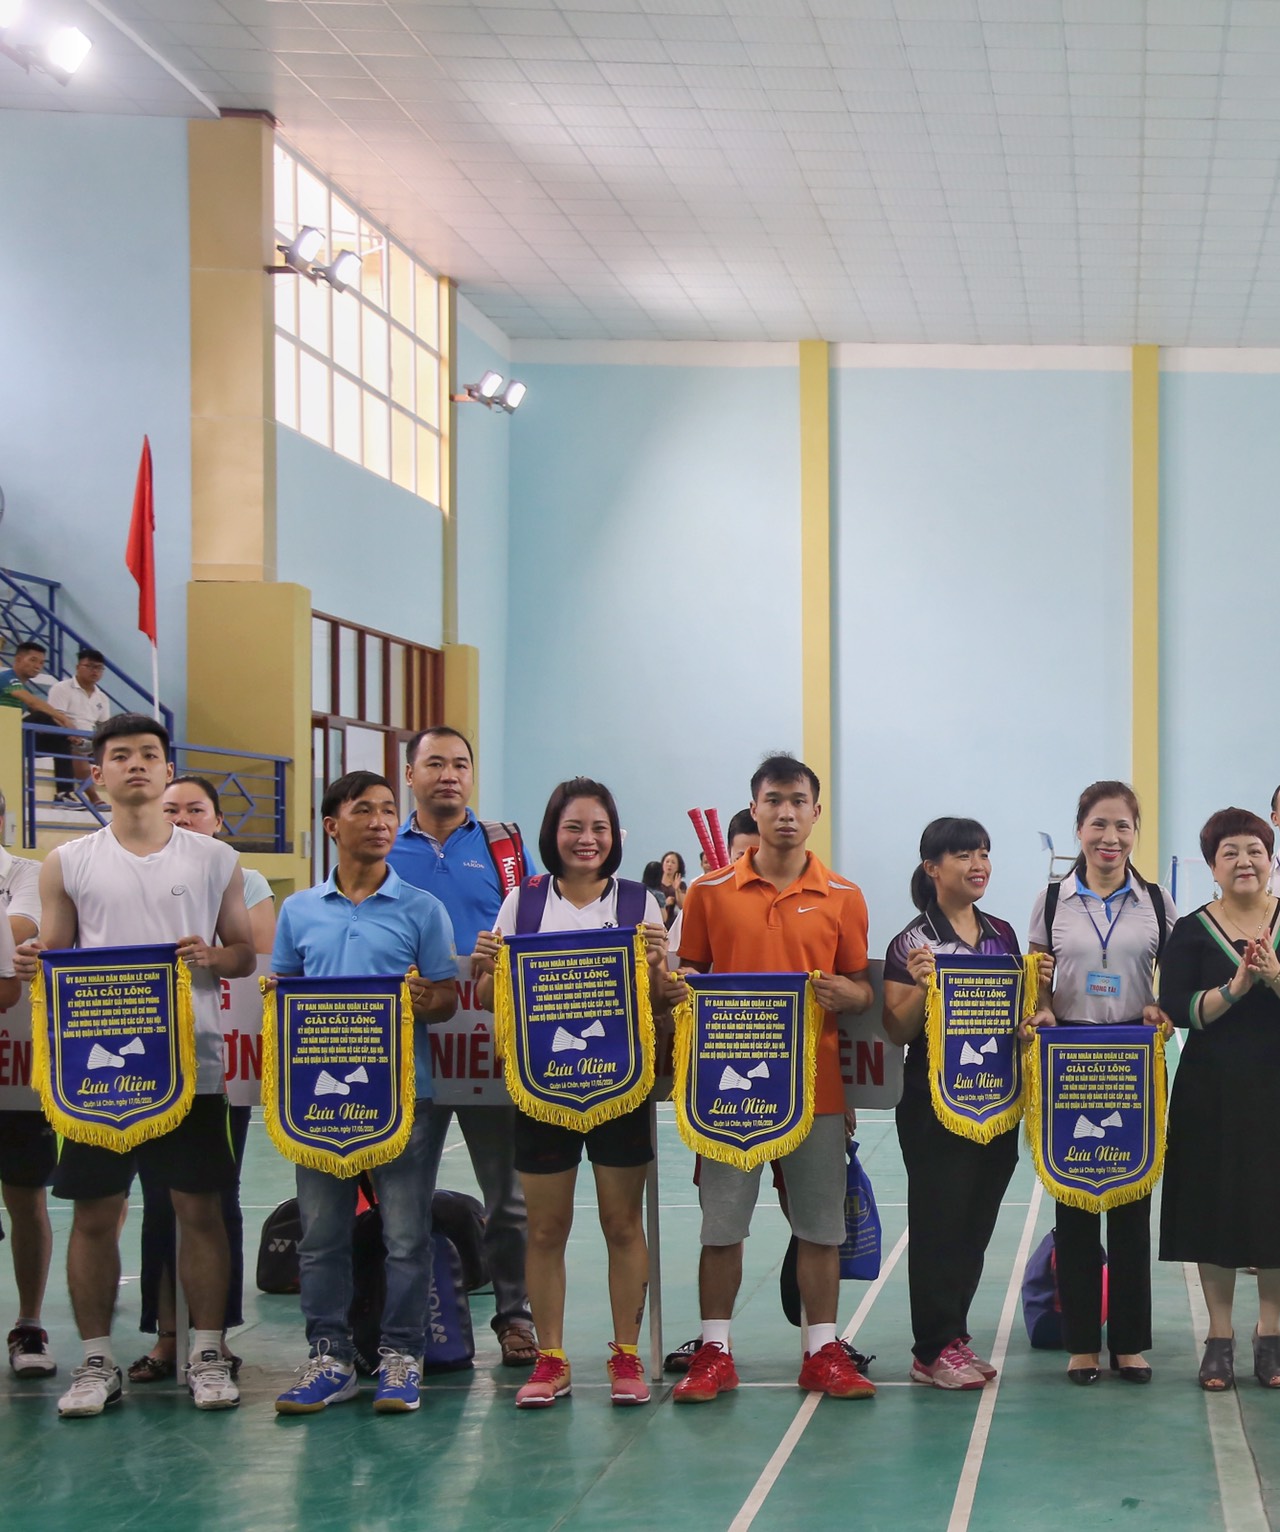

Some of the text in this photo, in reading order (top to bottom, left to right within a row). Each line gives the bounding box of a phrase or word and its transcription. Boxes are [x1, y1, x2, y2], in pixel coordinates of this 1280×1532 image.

[538, 968, 610, 982] GIẢI CẦU LÔNG
[75, 985, 152, 997] GIẢI CẦU LÔNG
[954, 988, 1006, 998] GIẢI CẦU LÔNG
[305, 1014, 377, 1024] GIẢI CẦU LÔNG
[713, 1010, 779, 1020] GIẢI CẦU LÔNG
[544, 1058, 615, 1080] Lưu Niệm
[1066, 1063, 1131, 1072] GIẢI CẦU LÔNG
[77, 1075, 155, 1098] Lưu Niệm
[954, 1072, 1002, 1092] Lưu Niệm
[304, 1103, 377, 1124] Lưu Niệm
[709, 1098, 776, 1118] Lưu Niệm
[1064, 1146, 1130, 1165] Lưu Niệm
